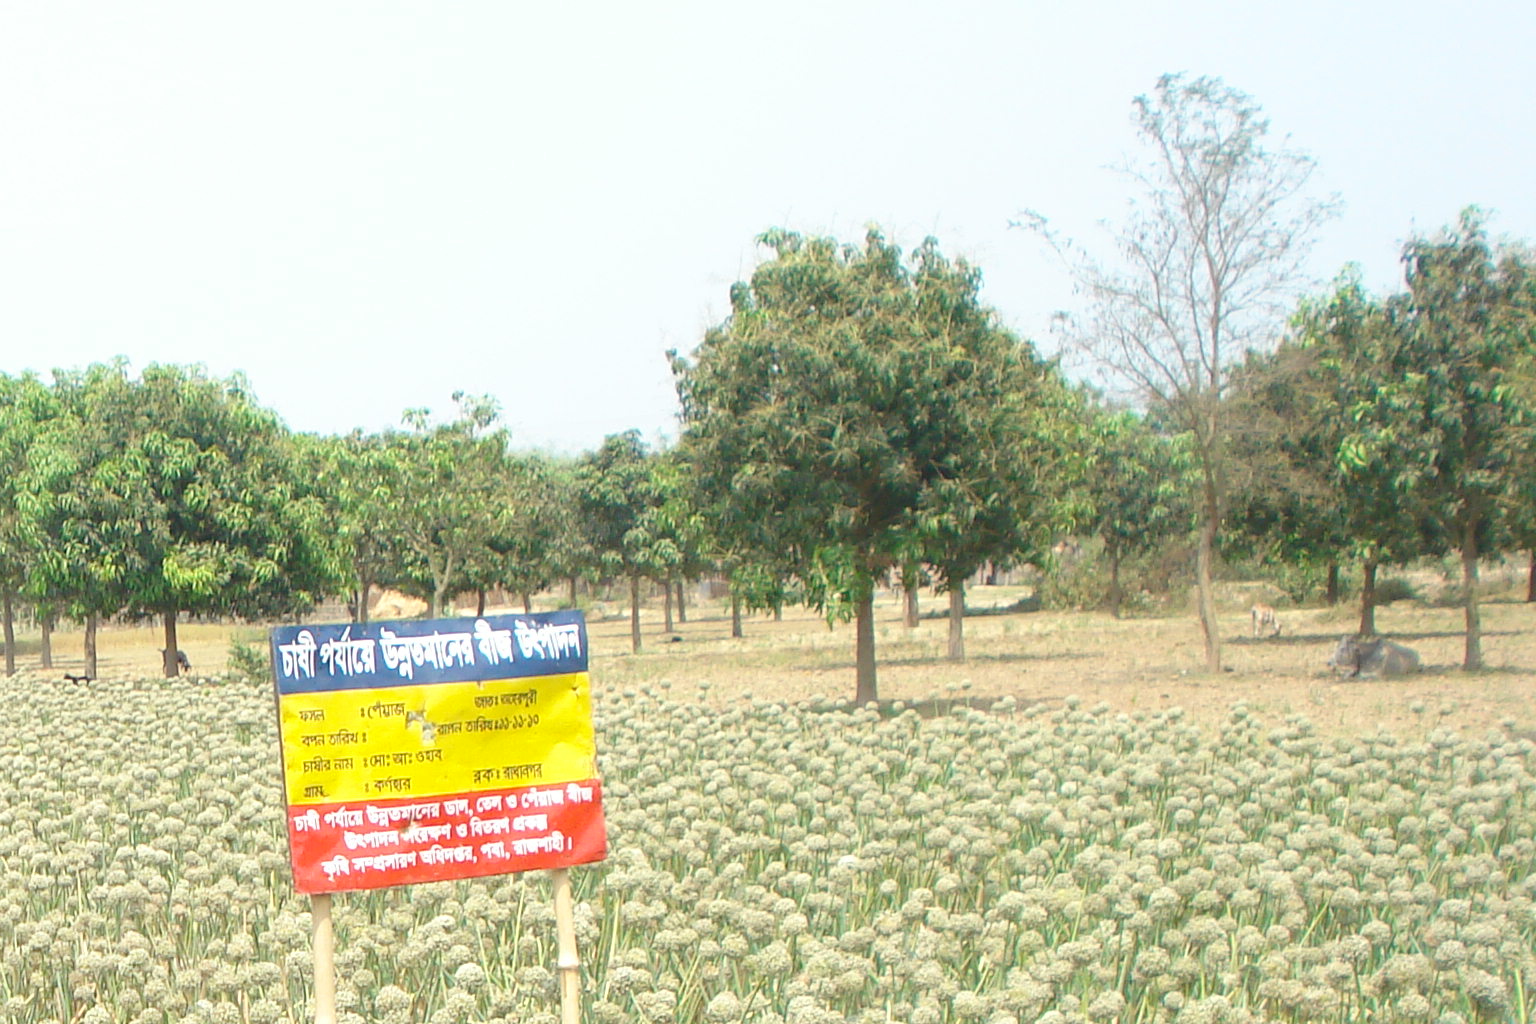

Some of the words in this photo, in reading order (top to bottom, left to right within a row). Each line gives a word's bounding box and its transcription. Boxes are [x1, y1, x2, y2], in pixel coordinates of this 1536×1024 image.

[279, 630, 317, 680] চাষী
[320, 626, 375, 676] পর্যায়ে
[379, 627, 475, 680] উন্নতমানের
[474, 619, 513, 665] বীজ
[515, 619, 581, 660] উৎপাদন
[299, 709, 325, 722] ফসল
[328, 729, 359, 746] তারিখ
[303, 755, 331, 773] চাষীর
[333, 757, 354, 770] নাম
[294, 809, 321, 831] চাষী
[324, 805, 364, 828] পর্যায়ে
[366, 802, 440, 827] উন্নতমানের
[443, 799, 473, 816] ডাল,
[476, 795, 502, 813] তেল
[506, 794, 518, 808] ও
[566, 783, 593, 803] বীজ
[344, 830, 400, 850] উৎপাদন
[456, 823, 468, 838] ও
[470, 816, 510, 837] বিতরণ
[321, 855, 350, 882] কৃষি
